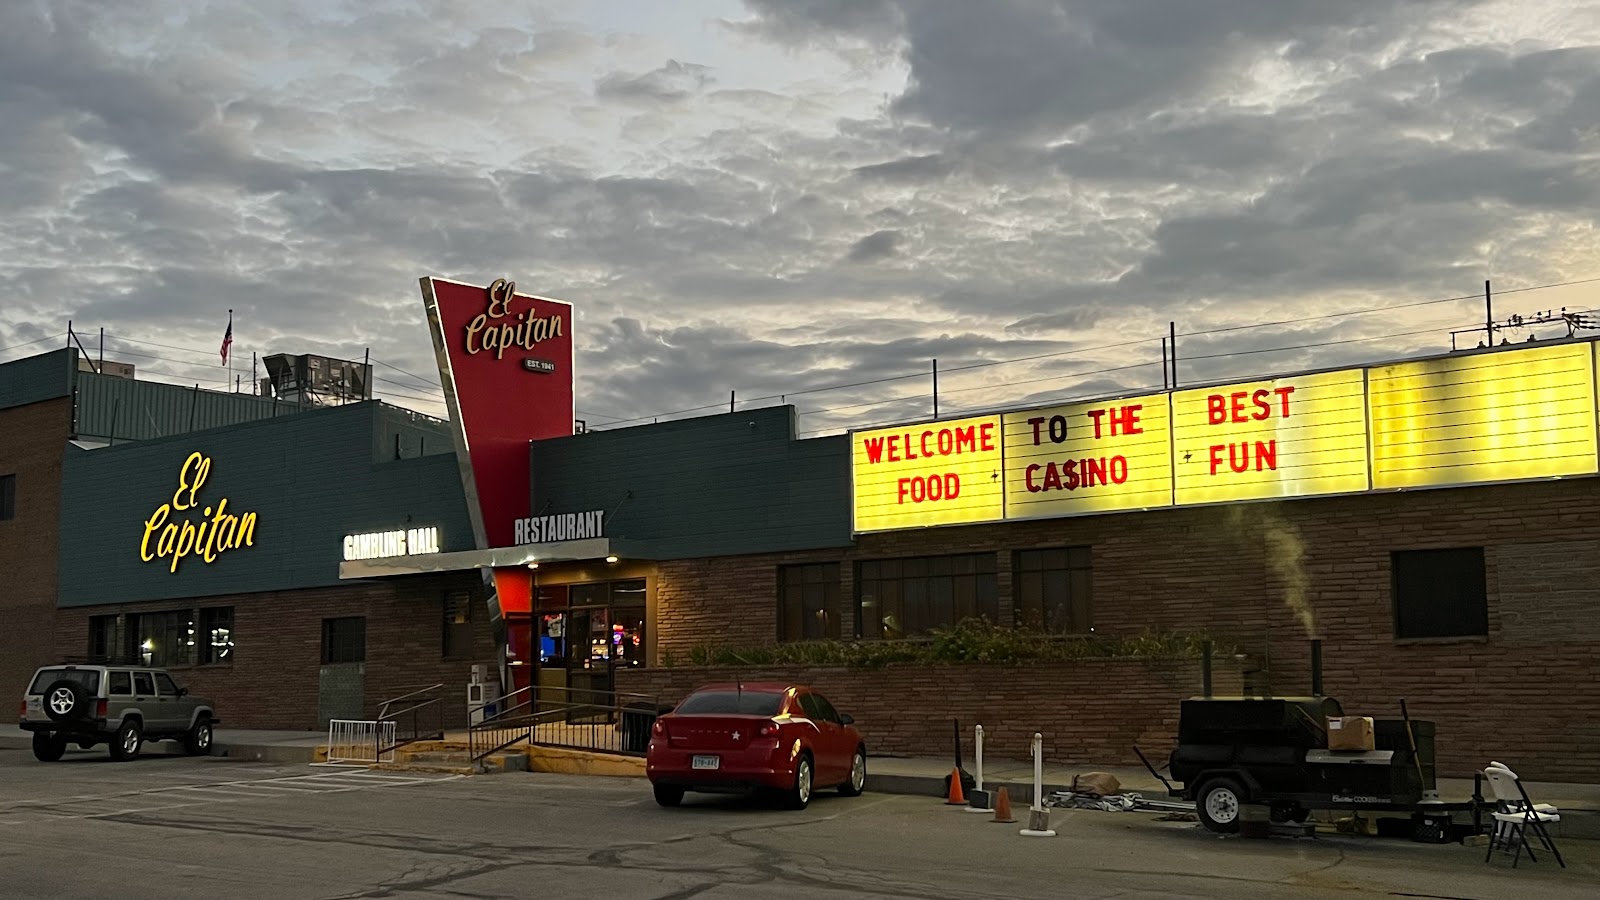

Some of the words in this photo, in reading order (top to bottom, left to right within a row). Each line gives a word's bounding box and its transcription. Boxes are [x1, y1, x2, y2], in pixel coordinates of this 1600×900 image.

[488, 278, 515, 318] El
[466, 307, 563, 360] Capitan
[863, 422, 995, 464] WELCOME
[1027, 414, 1068, 446] TO
[1087, 404, 1144, 440] THE
[1207, 385, 1295, 426] BEST
[172, 451, 211, 511] El
[897, 472, 960, 505] FOOD
[1209, 439, 1277, 476] FUN
[140, 498, 257, 573] Capitan
[343, 529, 407, 561] GAMBLING
[407, 526, 440, 556] HALL
[514, 510, 604, 545] RESTAURANT
